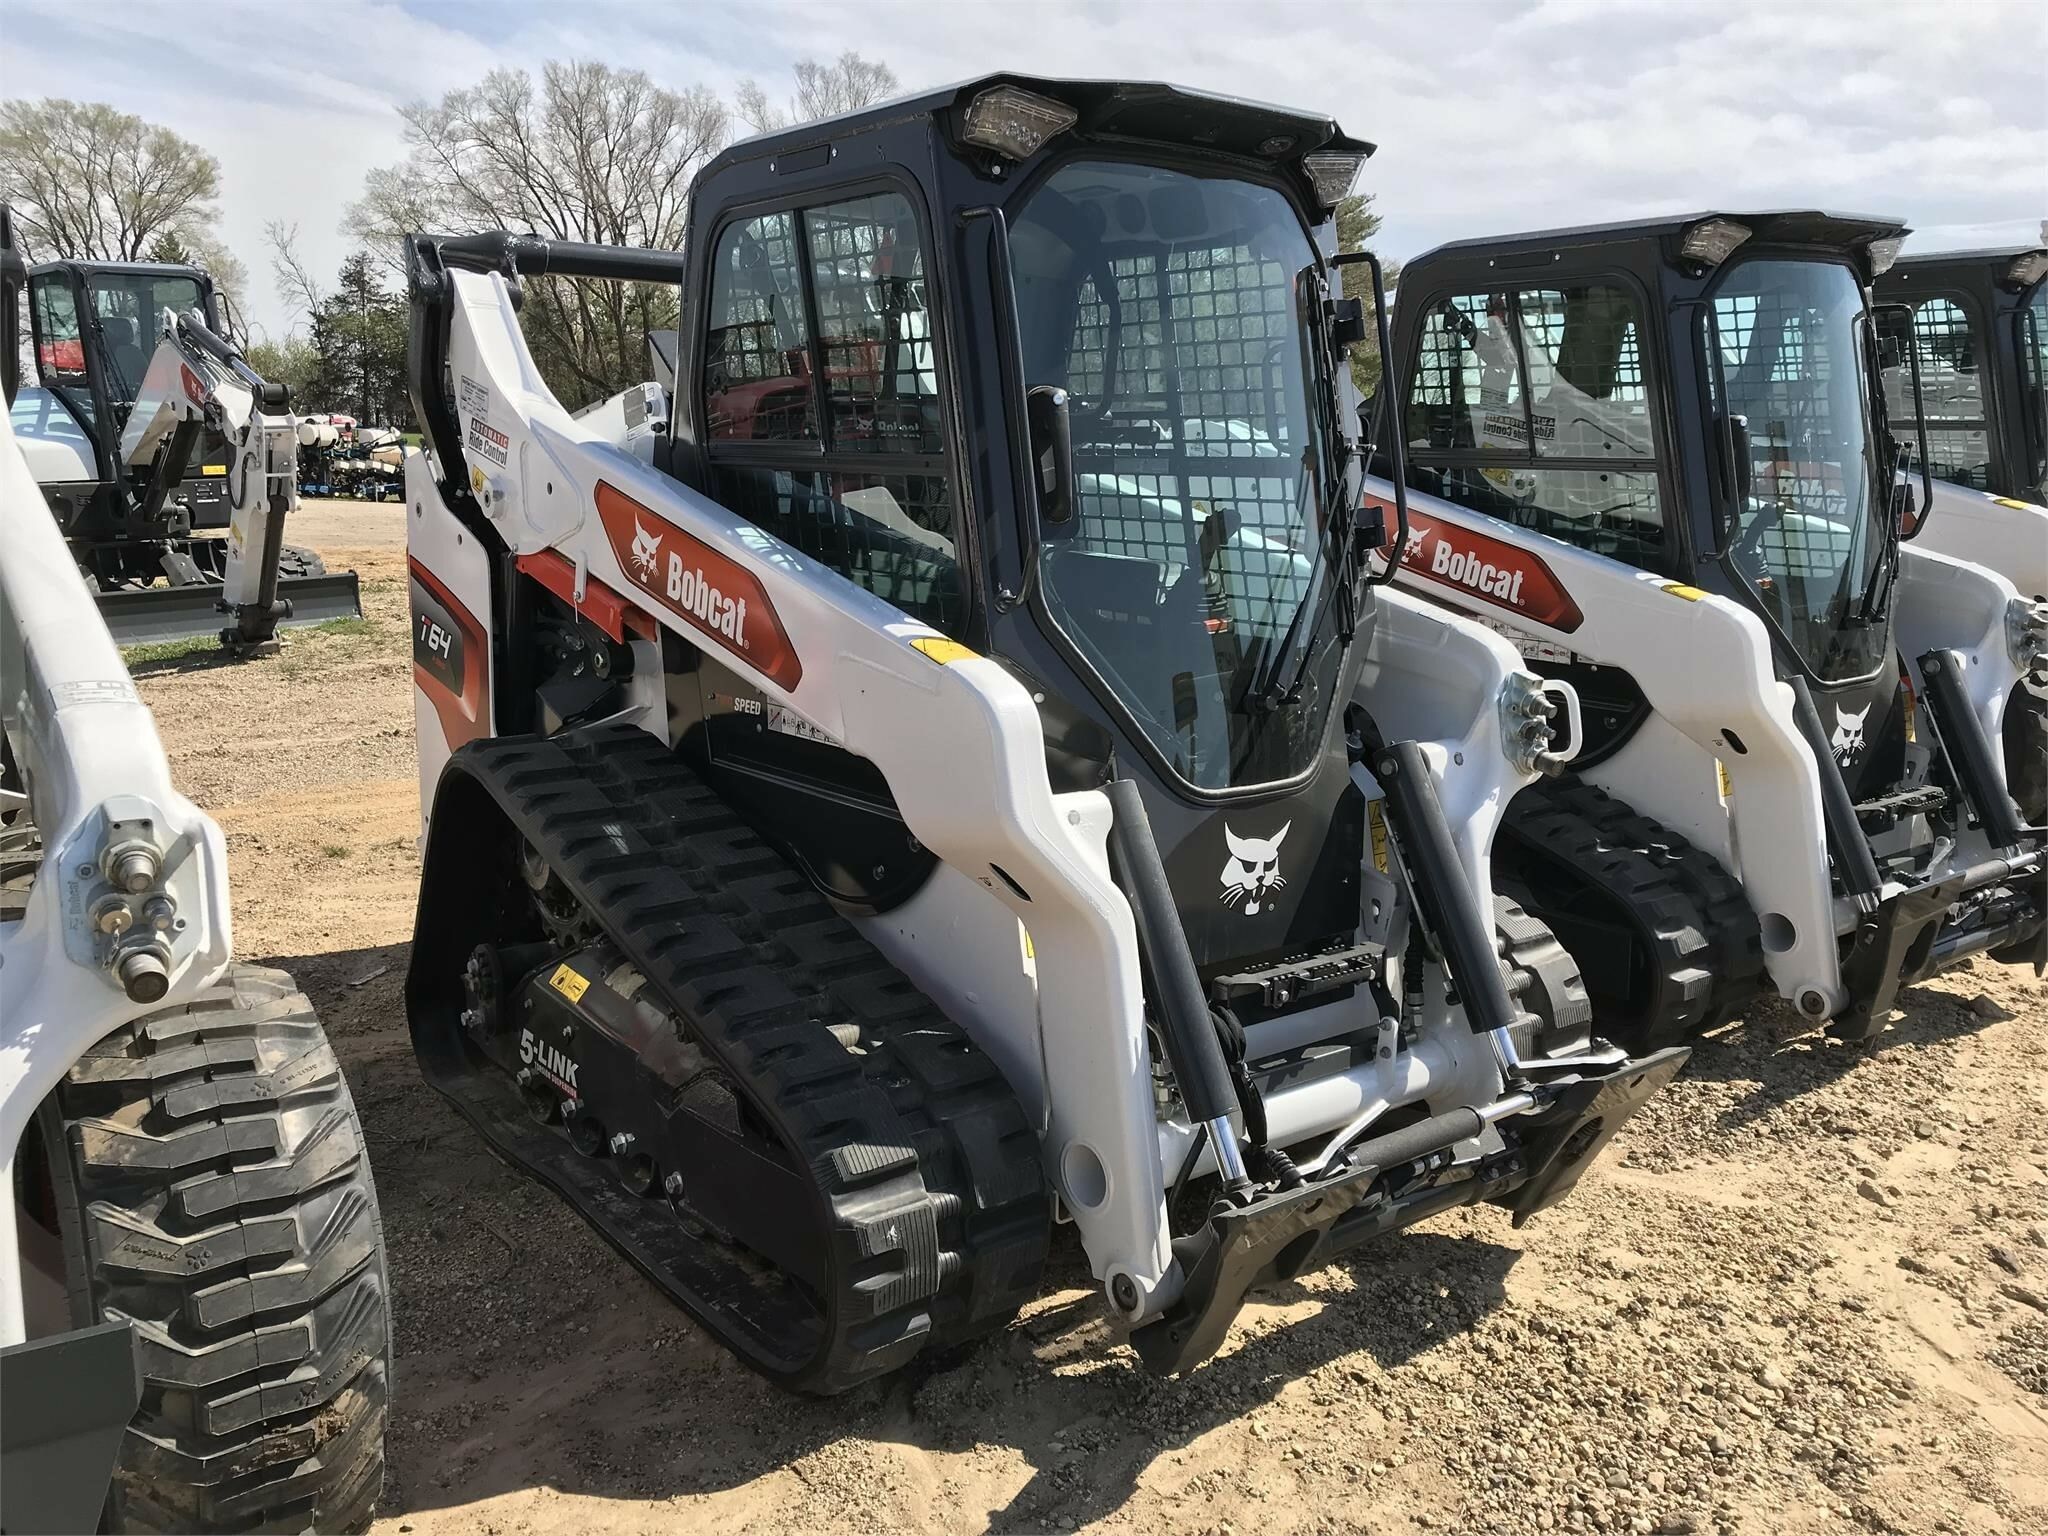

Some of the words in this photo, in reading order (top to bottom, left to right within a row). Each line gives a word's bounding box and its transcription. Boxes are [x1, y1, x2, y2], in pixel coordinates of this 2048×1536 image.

[469, 432, 483, 450] Ride
[484, 440, 508, 465] Control
[472, 419, 508, 449] AUTOMATIC
[1432, 539, 1524, 604] Bobcat
[666, 550, 746, 647] Bobcat
[421, 614, 452, 659] T64
[734, 697, 761, 716] SPEED
[519, 1027, 579, 1089] 5-LINK
